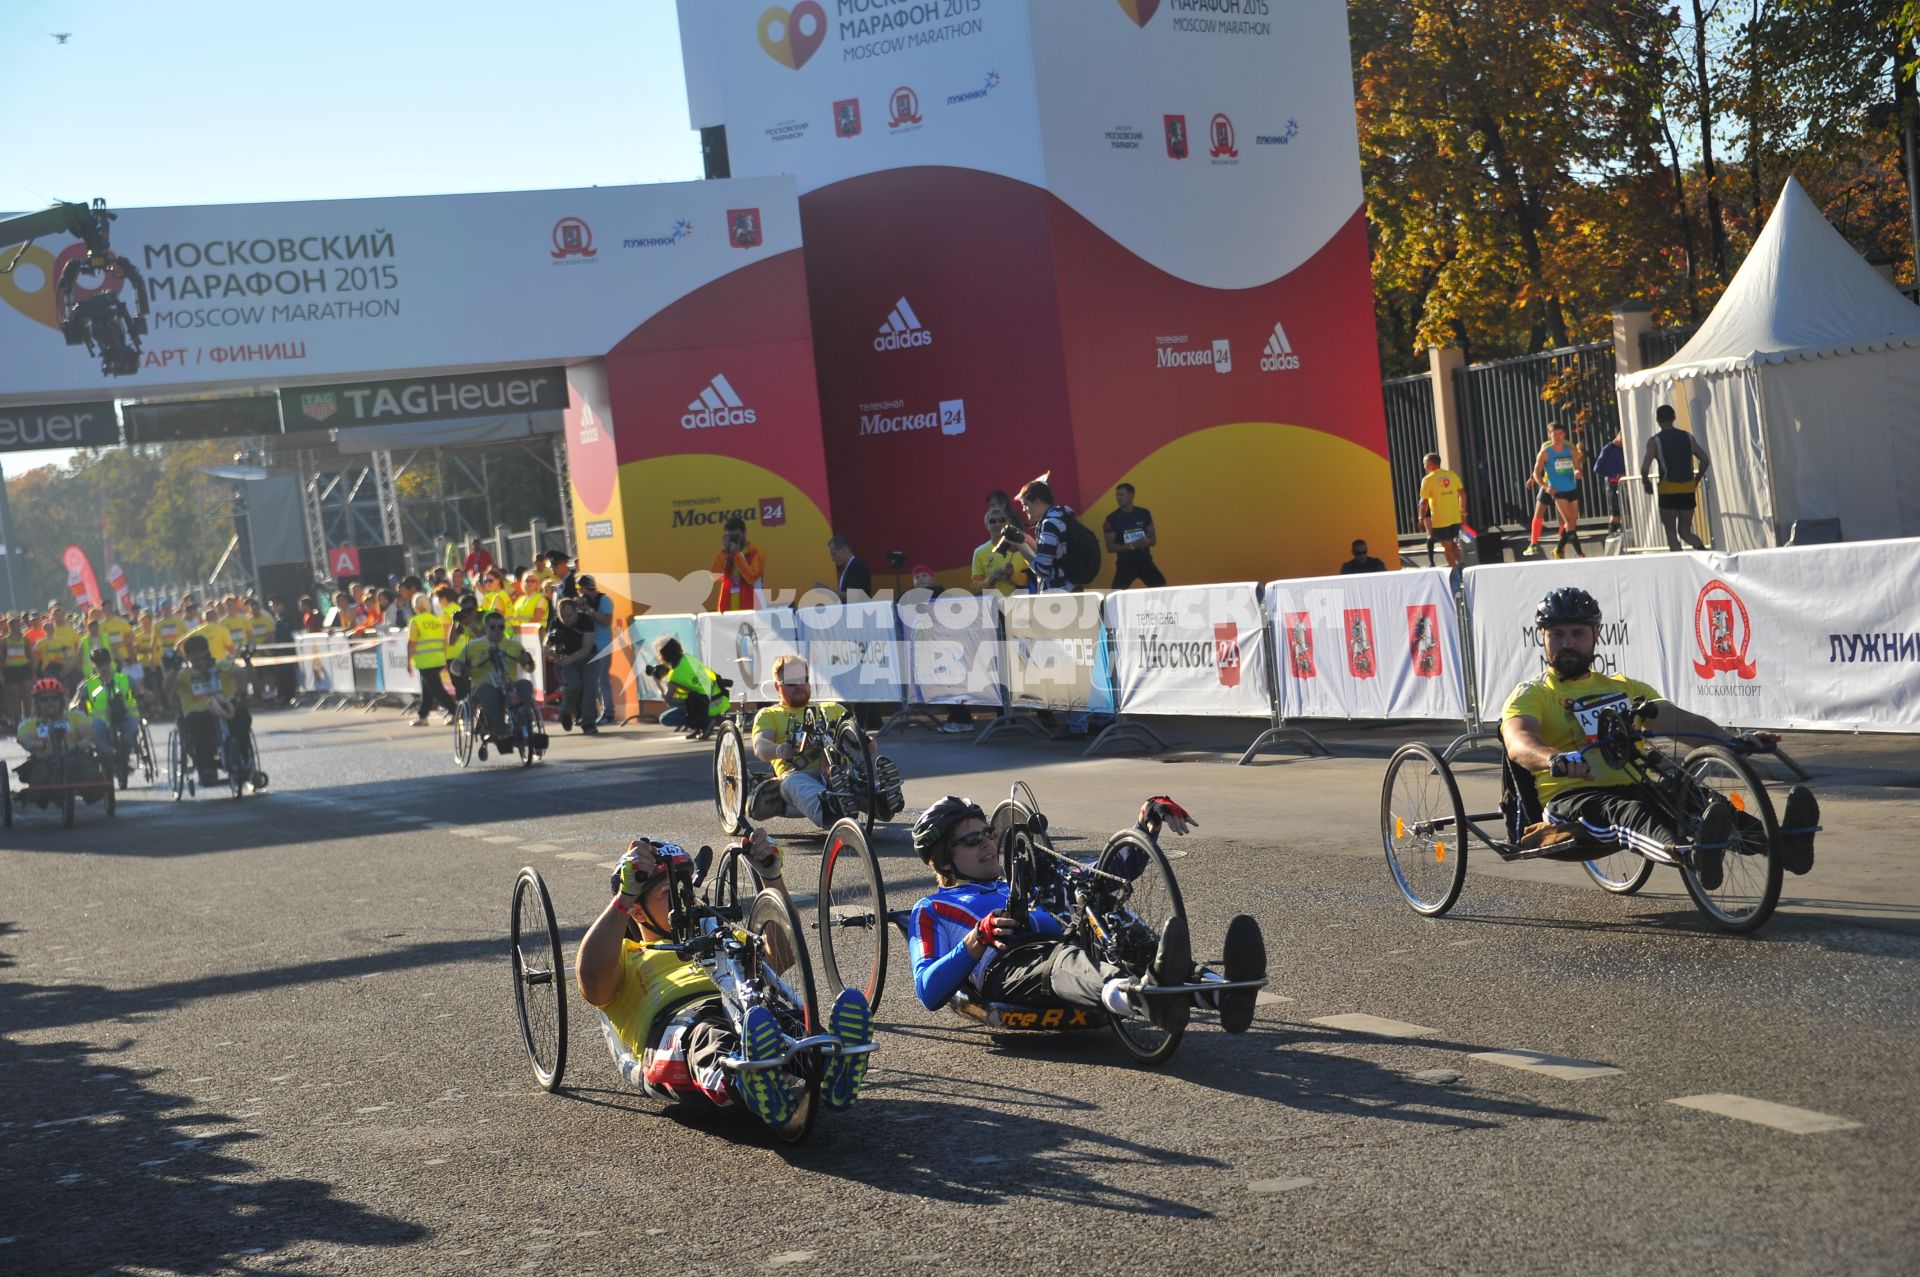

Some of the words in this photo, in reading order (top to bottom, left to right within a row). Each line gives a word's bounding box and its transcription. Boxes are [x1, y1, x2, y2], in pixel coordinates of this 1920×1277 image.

[840, 2, 939, 41] МАРАФОН
[944, 0, 981, 18] 2015
[1173, 18, 1216, 33] MOSCOW
[1218, 21, 1270, 36] MARATHON
[844, 36, 905, 62] MOSCOW
[908, 18, 982, 48] MARATHON
[144, 228, 395, 269] МОСКОВСКИЙ
[623, 236, 676, 249] ЛУЖНИКИ
[148, 268, 327, 301] МАРАФОН
[336, 265, 398, 292] 2015
[155, 306, 264, 330] MOSCOW
[272, 298, 400, 323] MARATHON
[874, 329, 932, 351] adidas
[143, 349, 188, 368] АРТ
[209, 341, 306, 363] ФИНИШ
[1157, 348, 1212, 368] Москва
[1216, 349, 1229, 363] 24
[1260, 353, 1299, 371] adidas
[859, 400, 904, 412] телеканал
[681, 409, 756, 429] adidas
[859, 412, 938, 435] Москва
[944, 408, 963, 425] 24
[672, 497, 721, 508] телеканал
[671, 505, 756, 528] Москва
[763, 505, 783, 519] 24
[336, 553, 355, 572] A
[1136, 611, 1179, 626] телеканал
[1138, 634, 1213, 672] Москва
[1218, 640, 1240, 668] 24
[1696, 685, 1762, 698] МОСКОМСПОРТ
